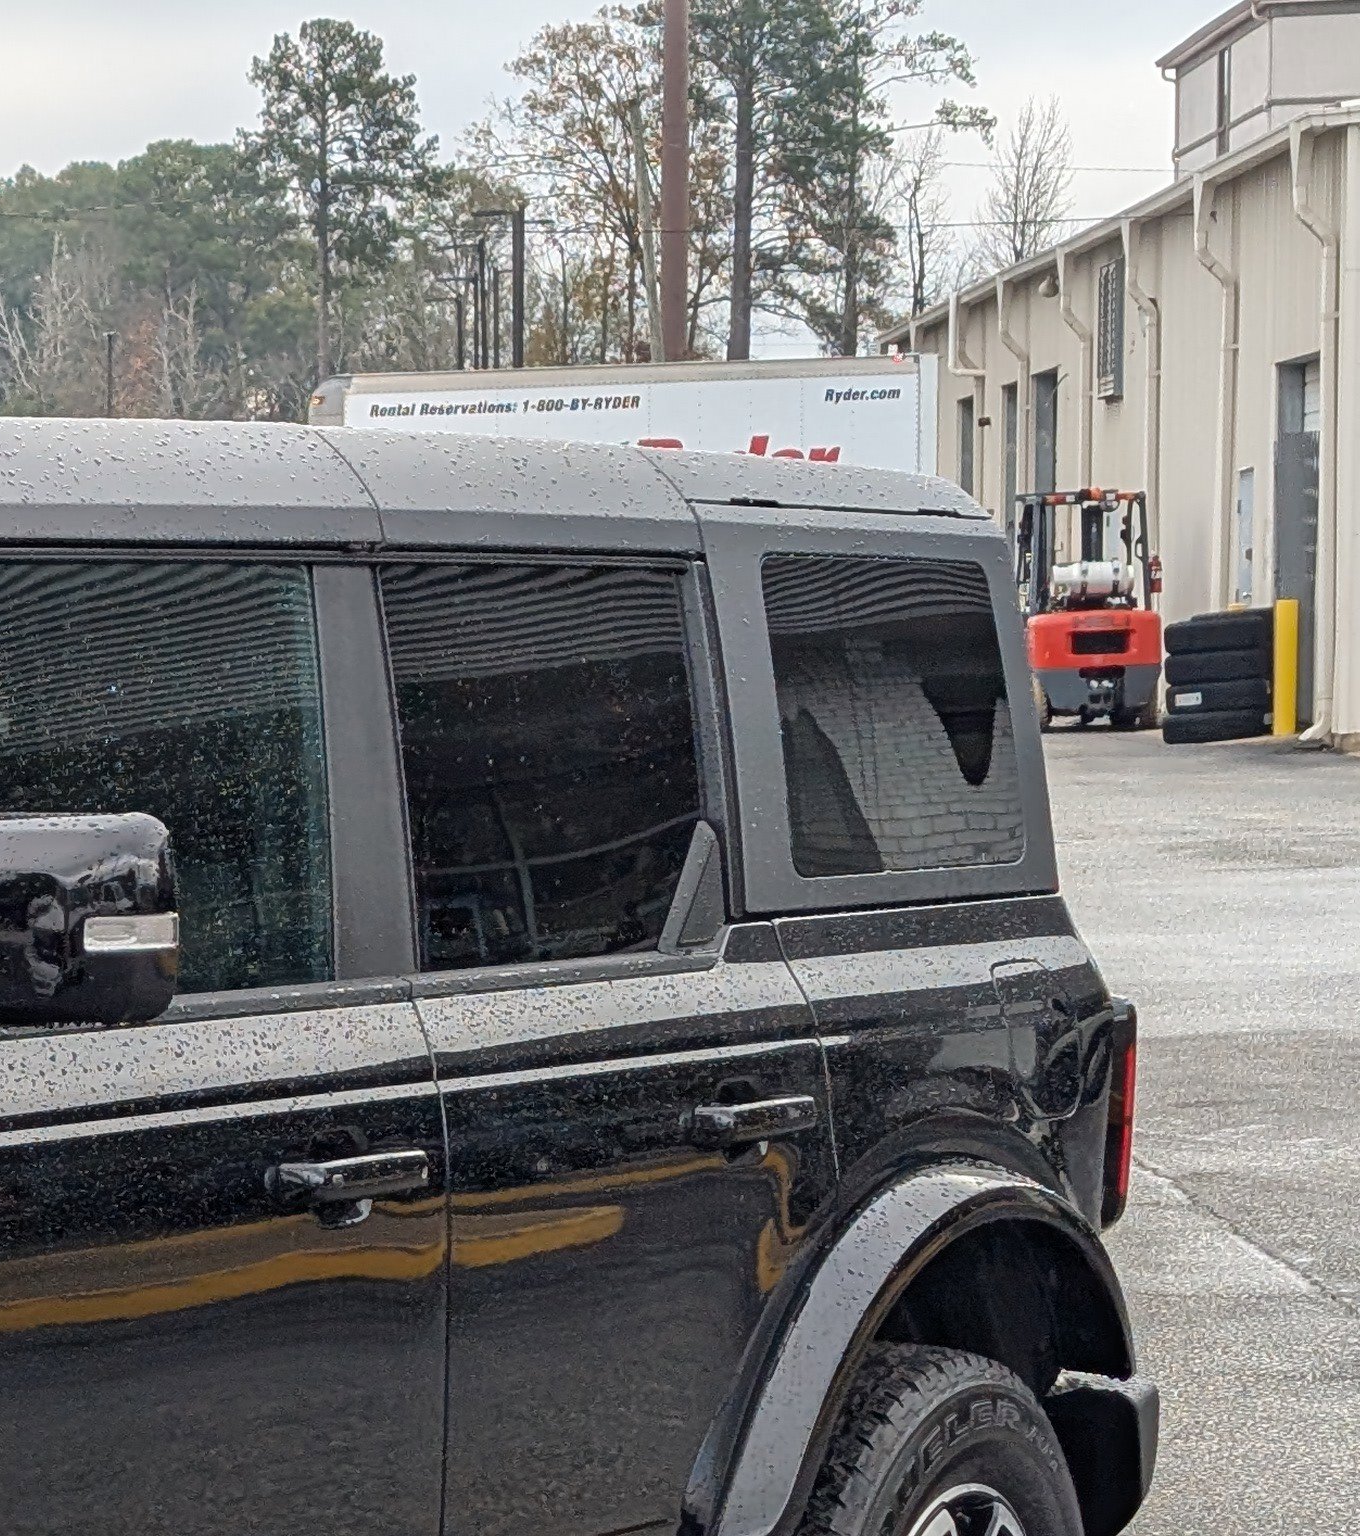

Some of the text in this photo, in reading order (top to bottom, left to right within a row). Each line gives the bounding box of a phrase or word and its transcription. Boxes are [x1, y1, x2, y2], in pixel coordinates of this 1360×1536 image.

[369, 395, 641, 417] Rental Reservations: 1-800-BY-RYDER
[824, 387, 901, 405] Ryder.com
